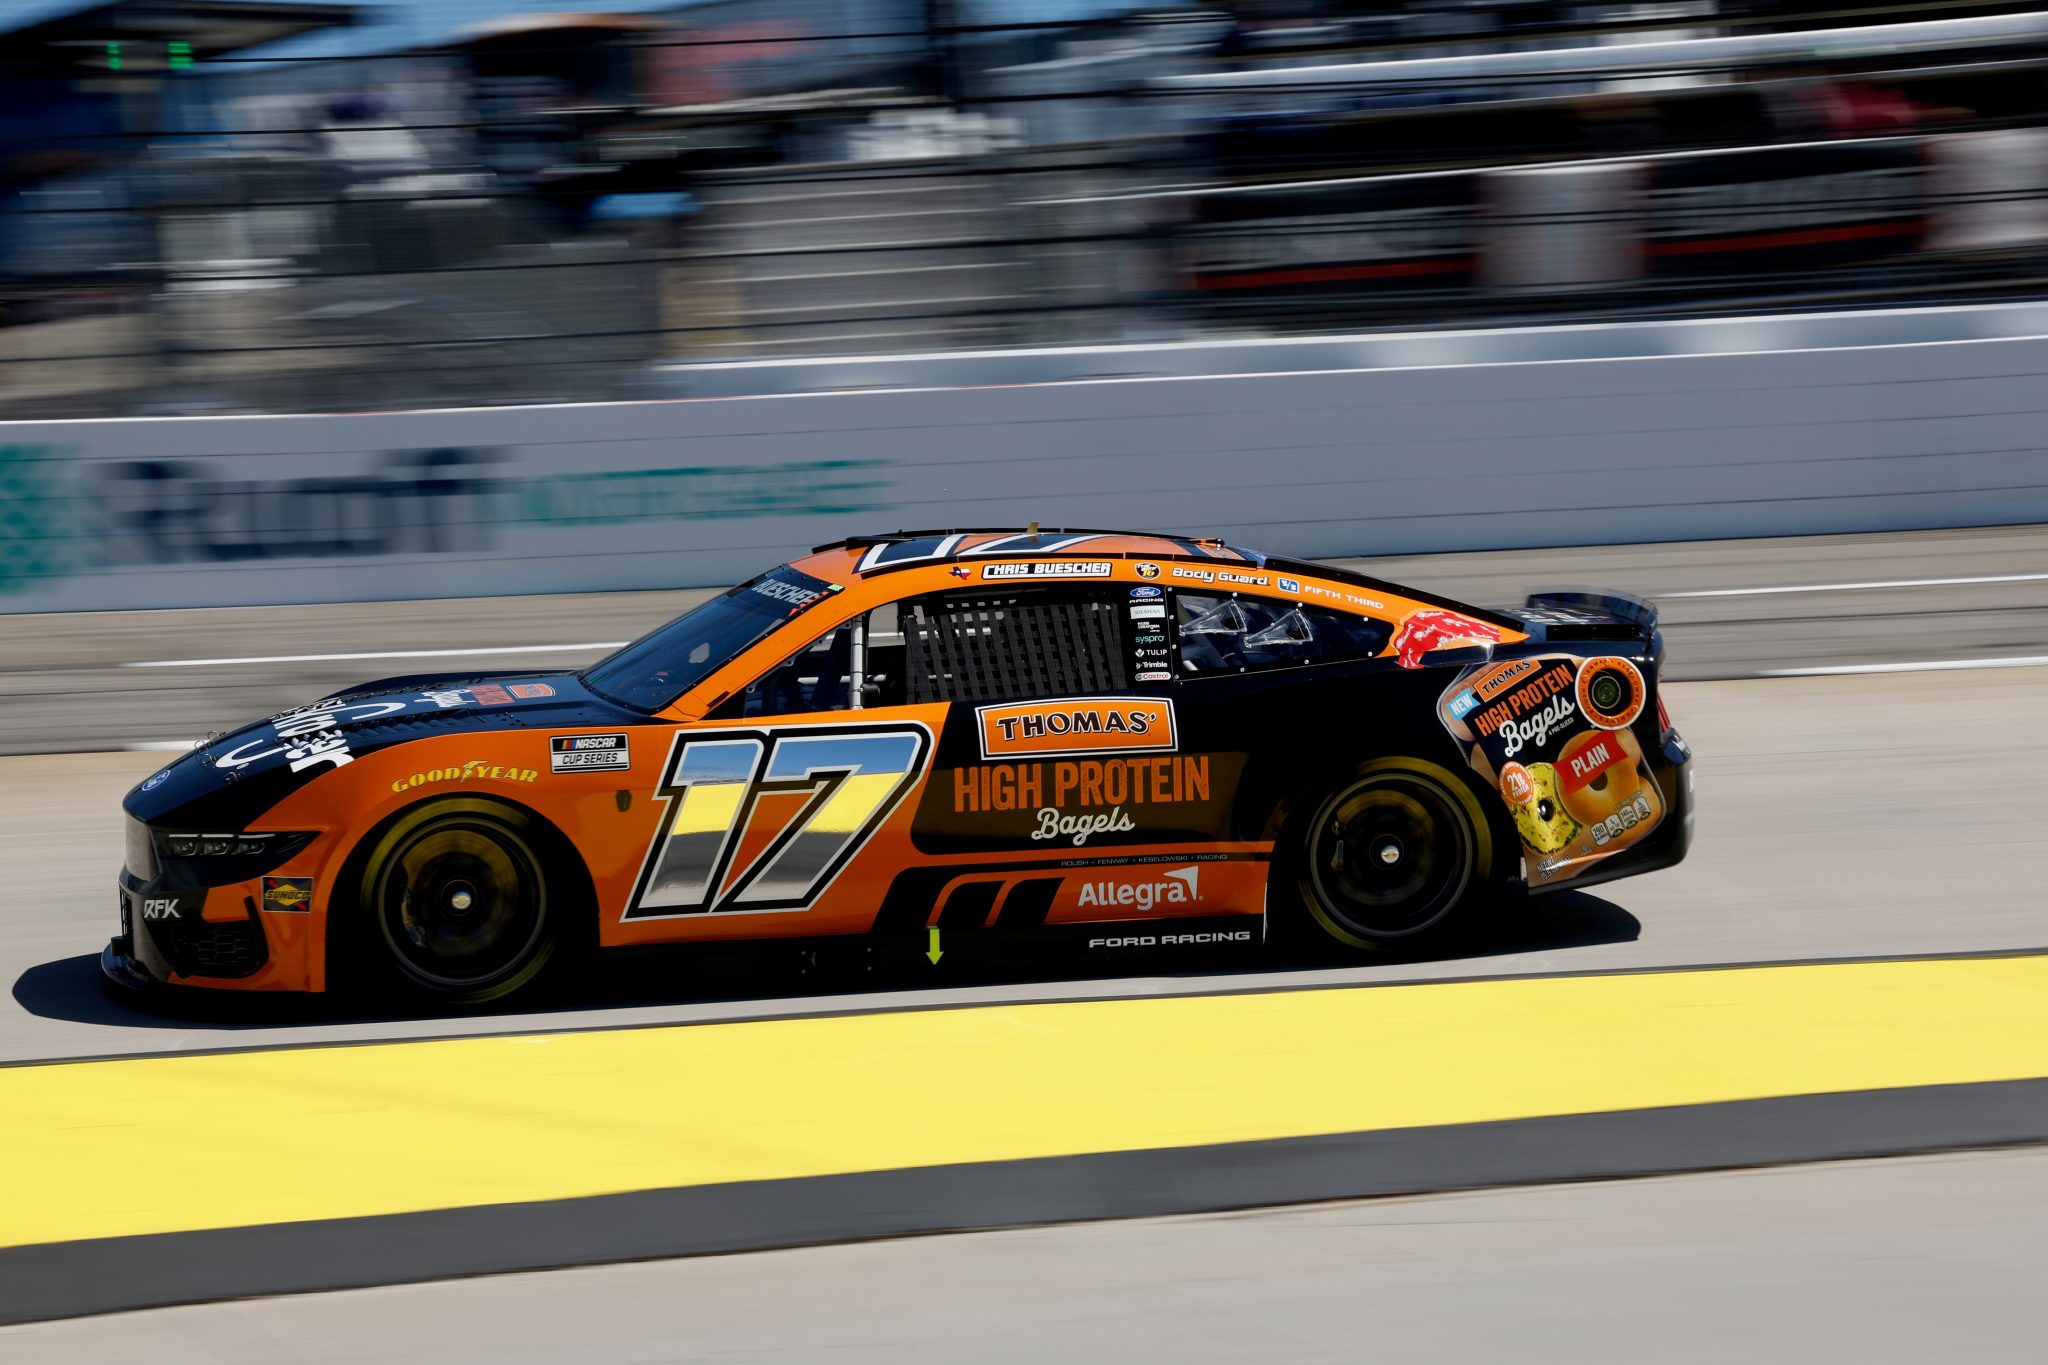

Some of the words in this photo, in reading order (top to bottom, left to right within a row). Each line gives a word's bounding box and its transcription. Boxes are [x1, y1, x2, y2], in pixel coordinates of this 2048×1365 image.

[984, 564, 1029, 577] CHRIS
[1034, 562, 1111, 575] BUESCHER
[1172, 567, 1215, 583] Body
[1217, 571, 1269, 586] Guard
[1304, 585, 1341, 599] FIFTH
[1345, 594, 1384, 609] THIRD
[1135, 635, 1164, 644] syspro
[1450, 693, 1473, 716] NEW
[1474, 700, 1514, 737] HIGH
[1508, 664, 1574, 717] PROTEIN
[996, 710, 1157, 741] THOMAS'
[1499, 694, 1575, 758] Bagels
[574, 737, 617, 749] NASCAR
[562, 753, 582, 765] CUP
[584, 752, 618, 764] SERIES
[1570, 742, 1611, 778] PLAIN
[391, 765, 539, 793] GOODYEAR
[954, 763, 1043, 813] HIGH
[1055, 756, 1210, 807] PROTEIN
[619, 720, 935, 924] 17
[1031, 806, 1136, 846] Bagels
[1060, 859, 1089, 867] ROUSH
[1097, 857, 1129, 865] FENWAY
[1138, 855, 1188, 863] KESELOWSKI
[265, 889, 312, 900] SUNOCO
[1077, 881, 1188, 911] Allegra
[144, 898, 182, 919] RFK
[1089, 935, 1156, 949] FORD
[1161, 931, 1251, 945] RACING
